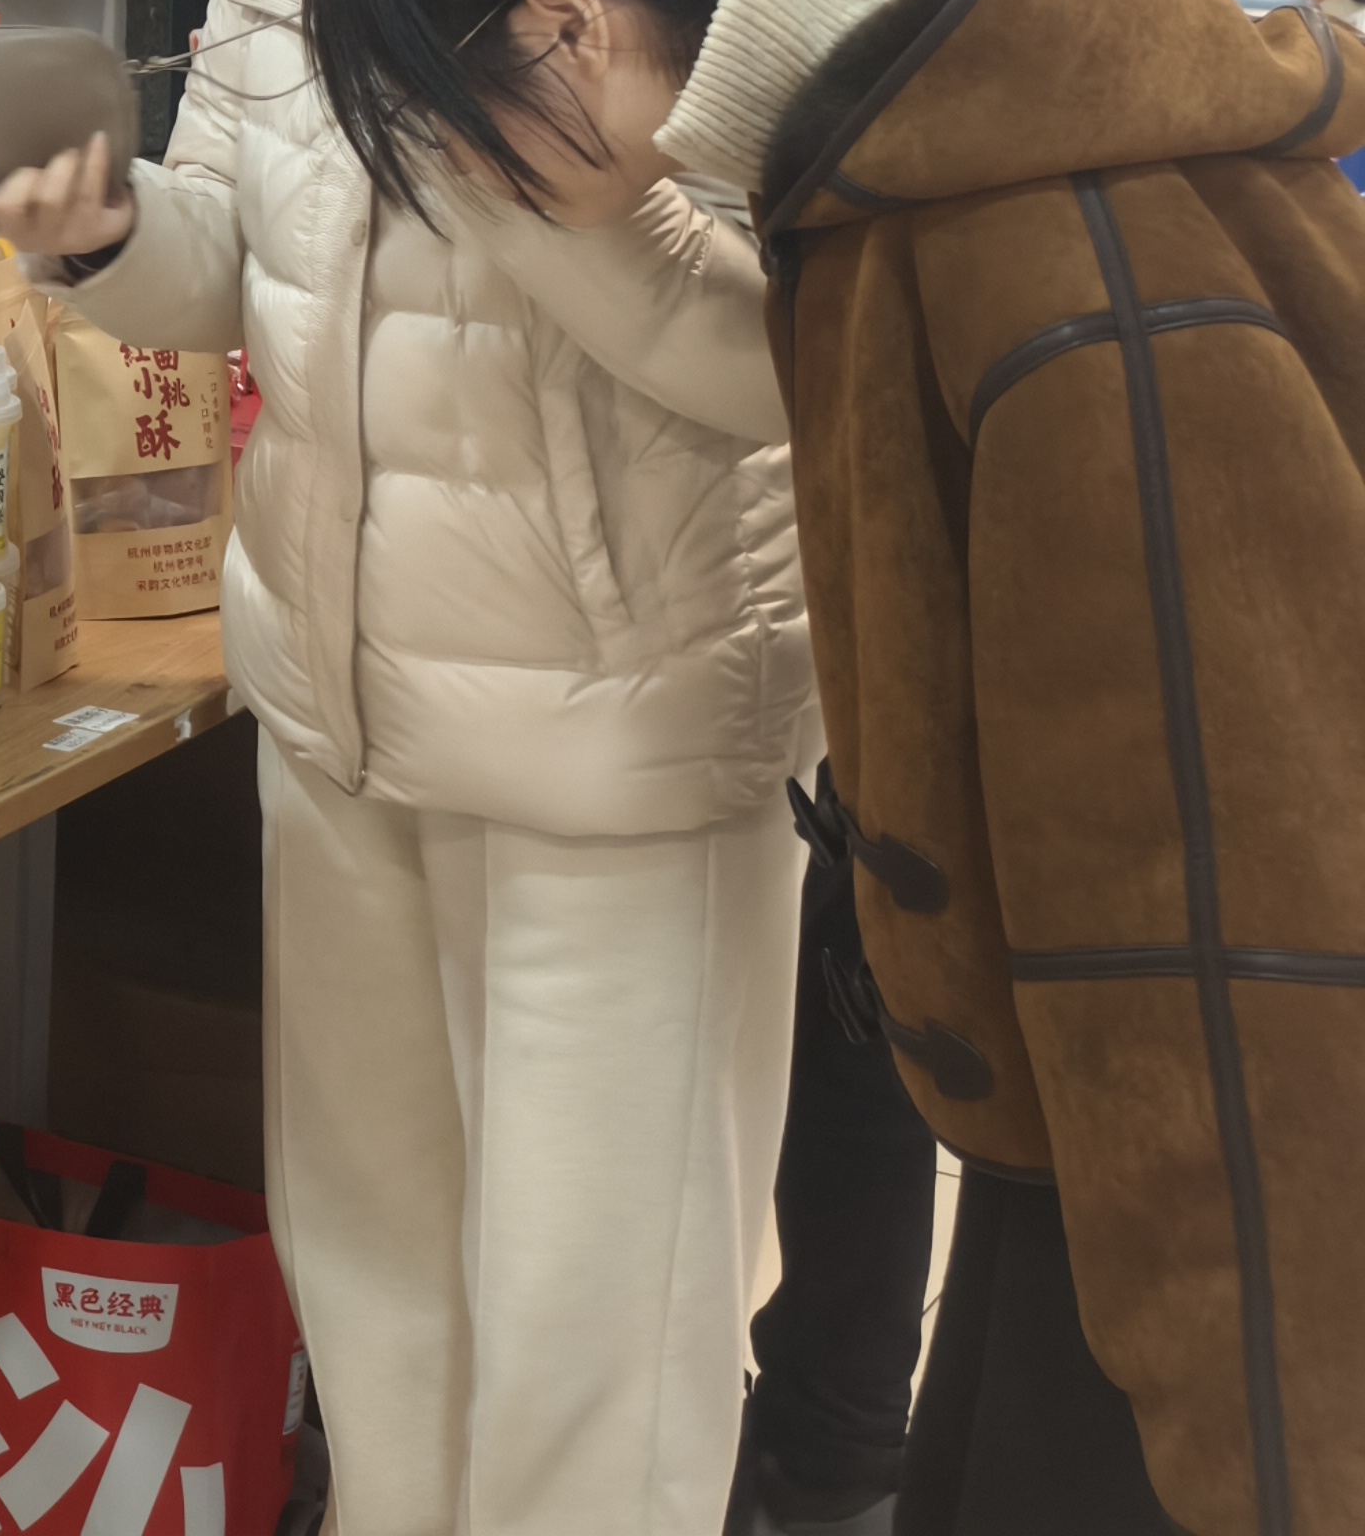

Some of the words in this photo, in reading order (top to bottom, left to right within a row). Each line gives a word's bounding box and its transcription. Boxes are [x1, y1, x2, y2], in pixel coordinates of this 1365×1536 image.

[134, 408, 181, 462] 酥
[52, 1281, 166, 1322] 黑色经典
